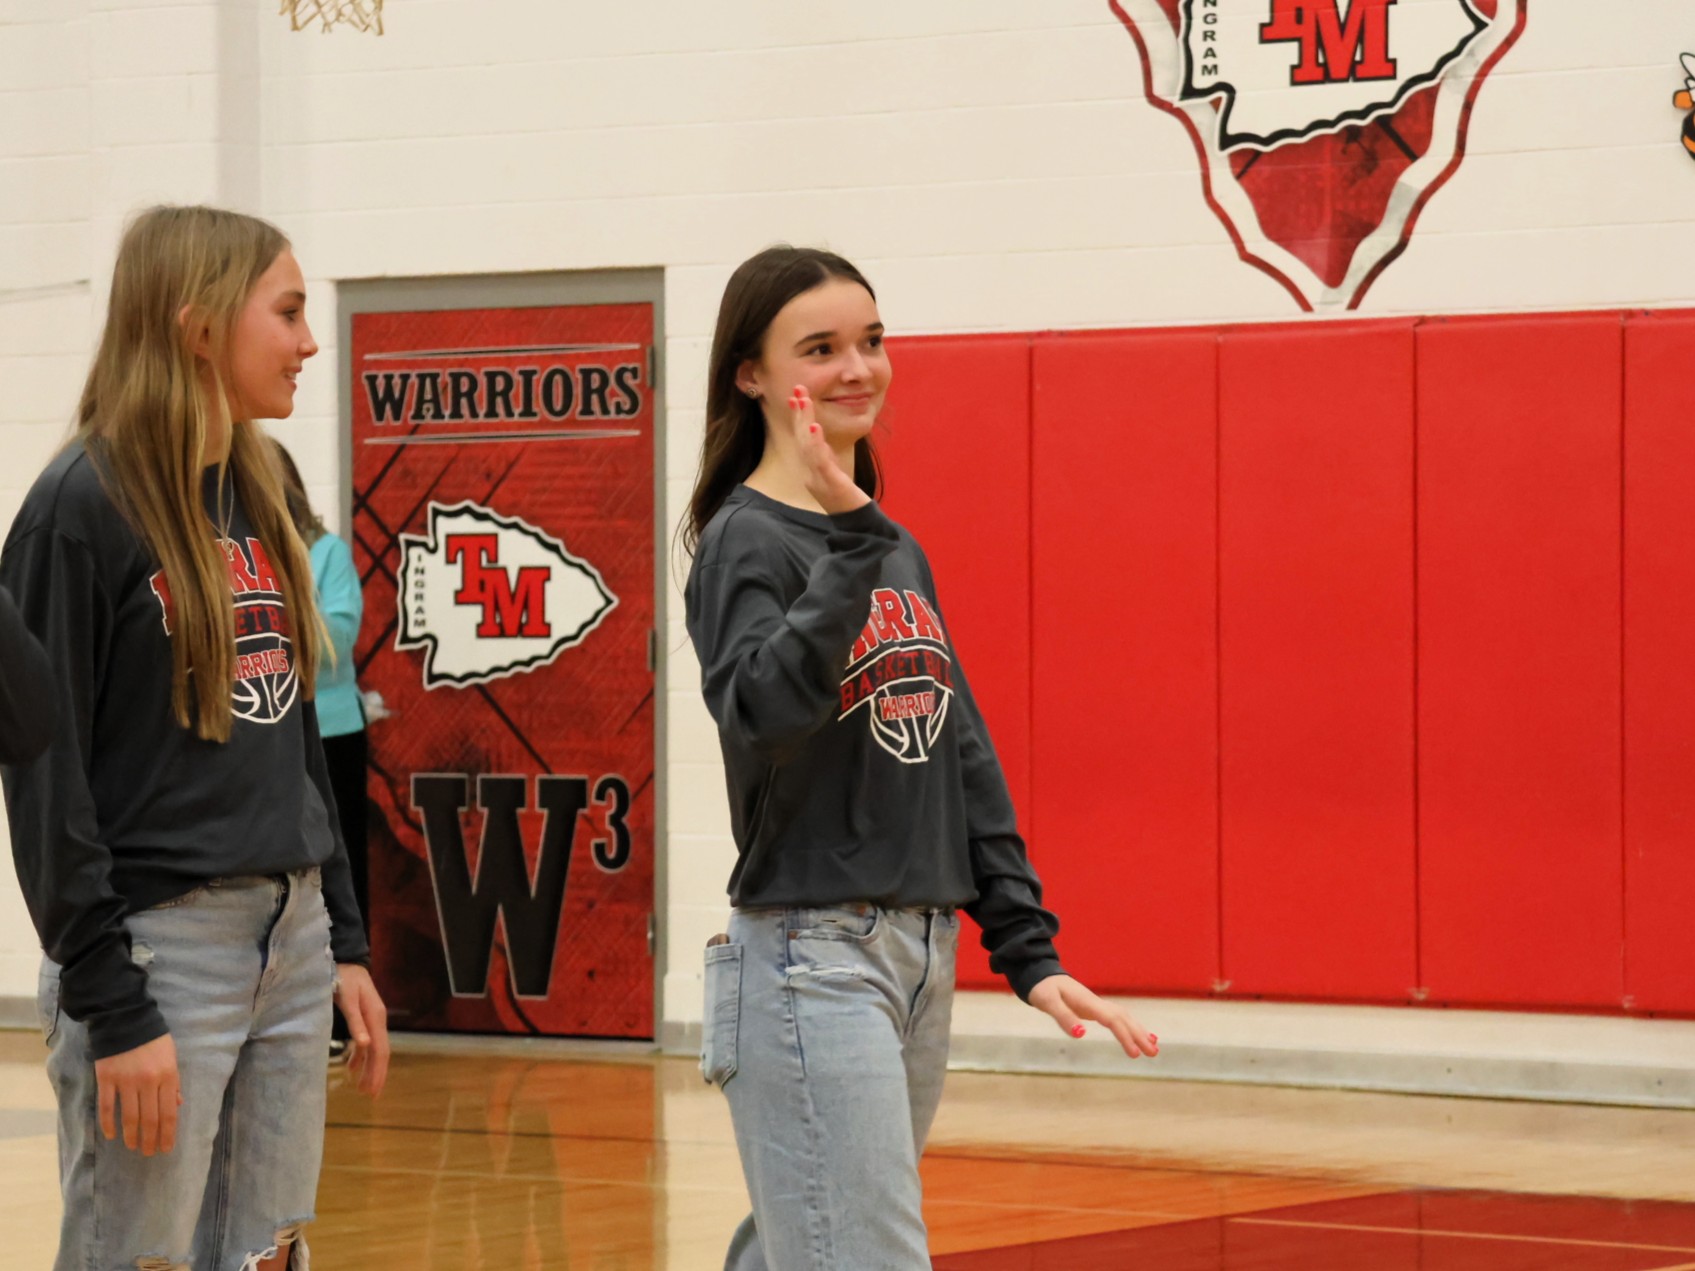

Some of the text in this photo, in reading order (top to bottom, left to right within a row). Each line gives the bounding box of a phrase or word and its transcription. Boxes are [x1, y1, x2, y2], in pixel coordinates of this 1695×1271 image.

[1201, 0, 1218, 76] NGRAM
[362, 363, 641, 425] WARRIORS
[413, 553, 427, 628] INGRAM
[445, 533, 551, 639] TM
